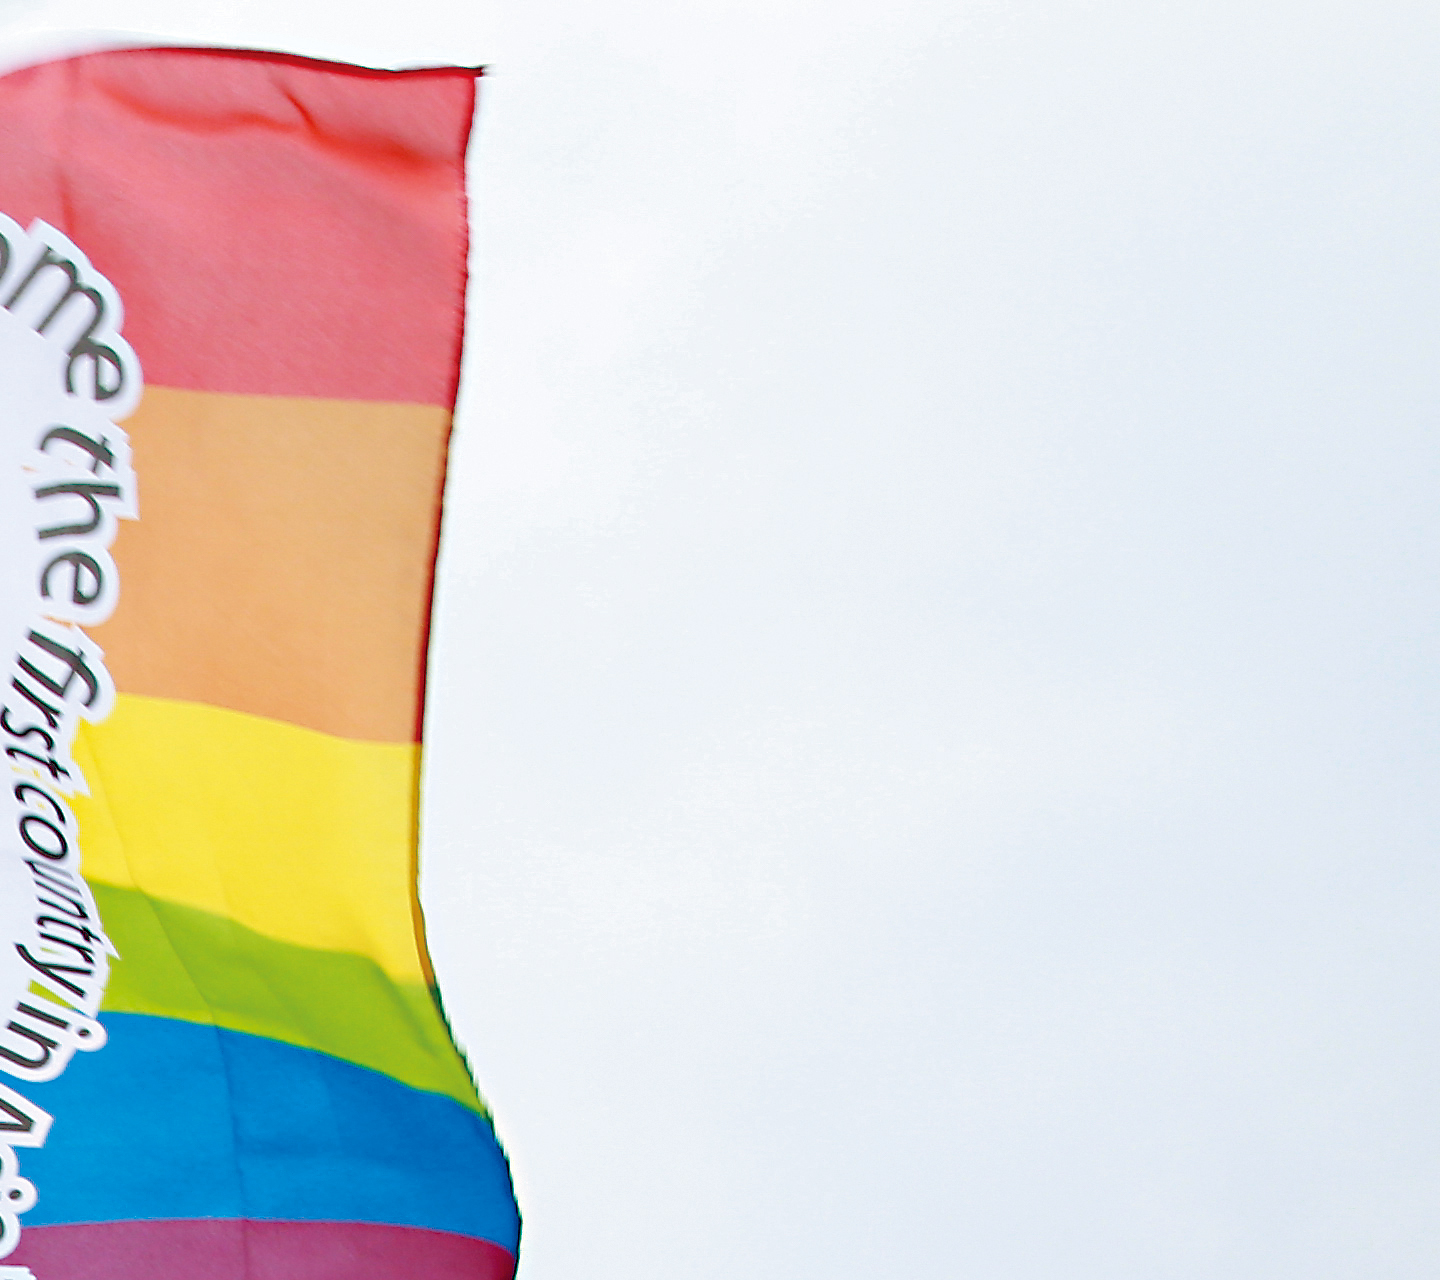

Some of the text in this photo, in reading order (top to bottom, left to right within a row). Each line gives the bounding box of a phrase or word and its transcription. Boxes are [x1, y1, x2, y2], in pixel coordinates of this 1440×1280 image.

[36, 426, 122, 606] the
[0, 630, 99, 782] first
[15, 782, 95, 998] country
